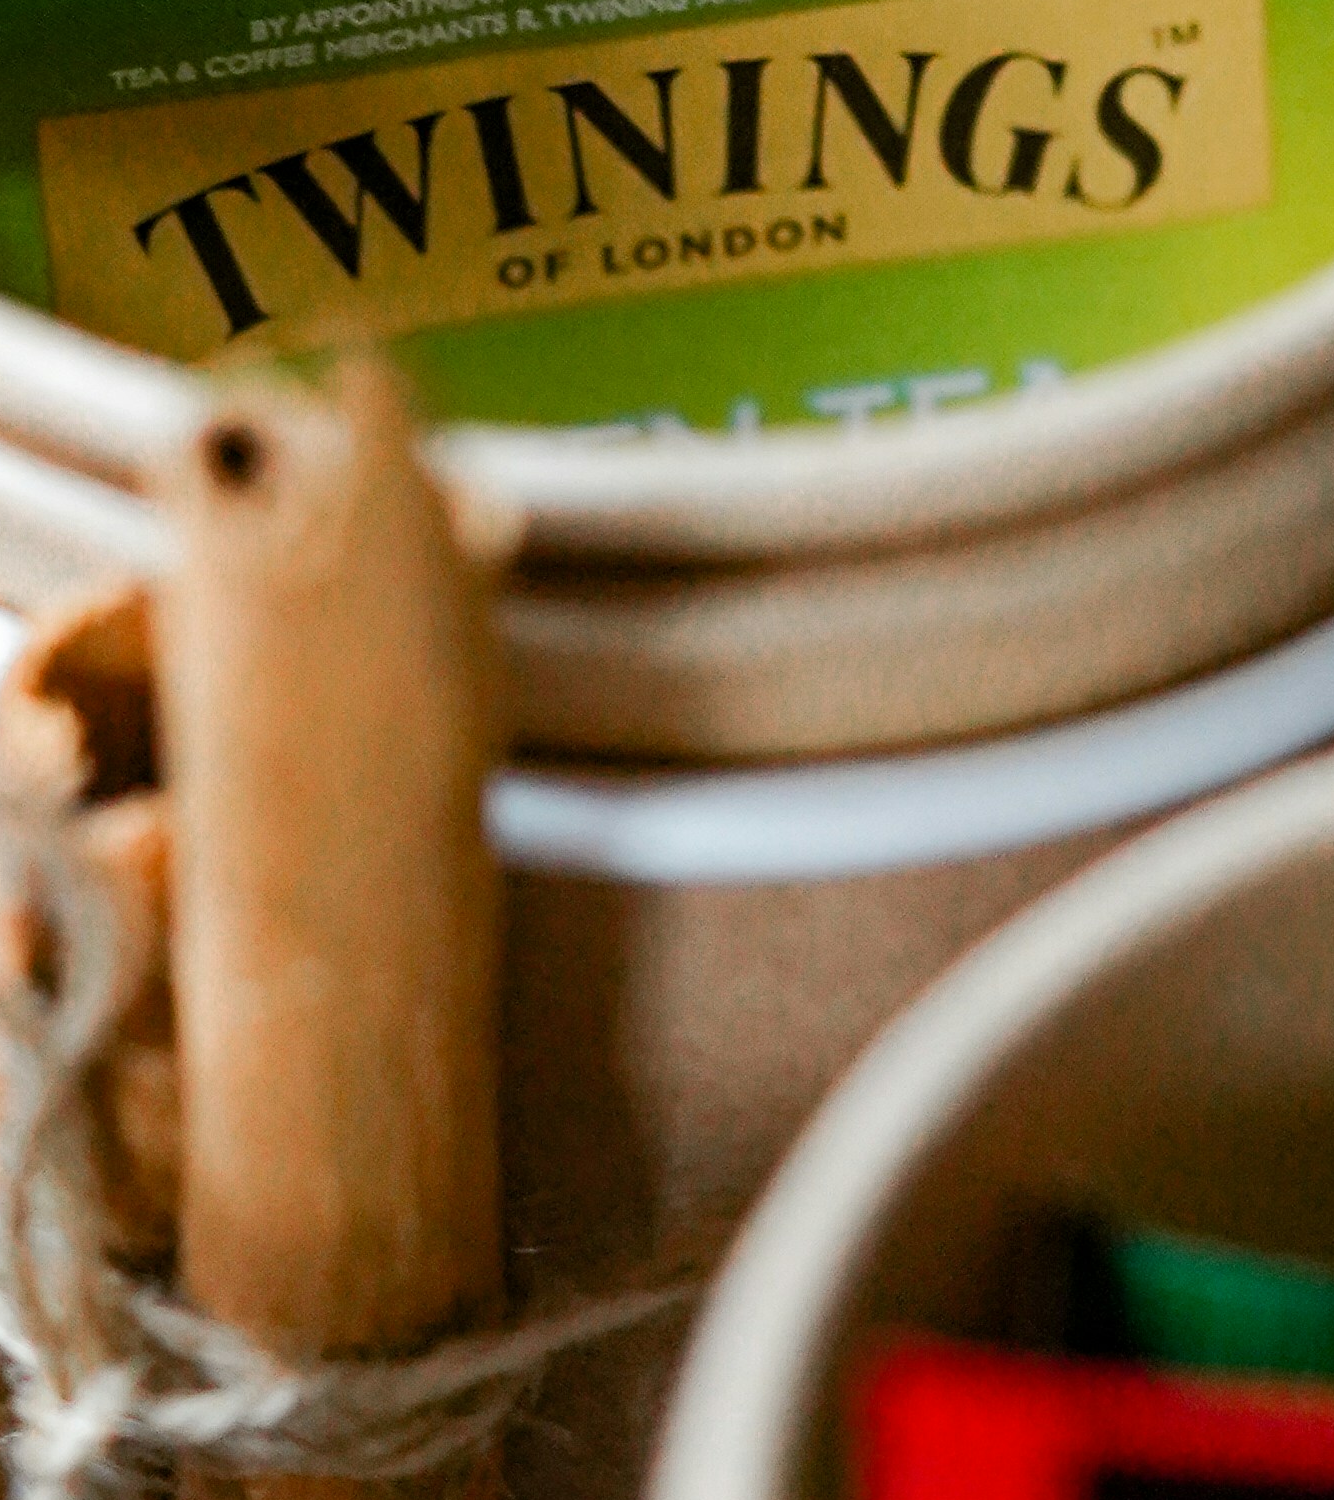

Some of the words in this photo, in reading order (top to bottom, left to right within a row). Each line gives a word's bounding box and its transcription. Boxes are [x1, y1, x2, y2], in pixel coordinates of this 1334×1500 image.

[111, 67, 167, 90] TEA
[175, 61, 197, 83] &
[204, 43, 315, 79] COFFEE
[324, 12, 508, 61] MERCHANTS
[249, 16, 288, 43] BY
[133, 50, 1191, 342] TWININGS
[498, 252, 567, 290] OF
[601, 213, 849, 276] LONDON
